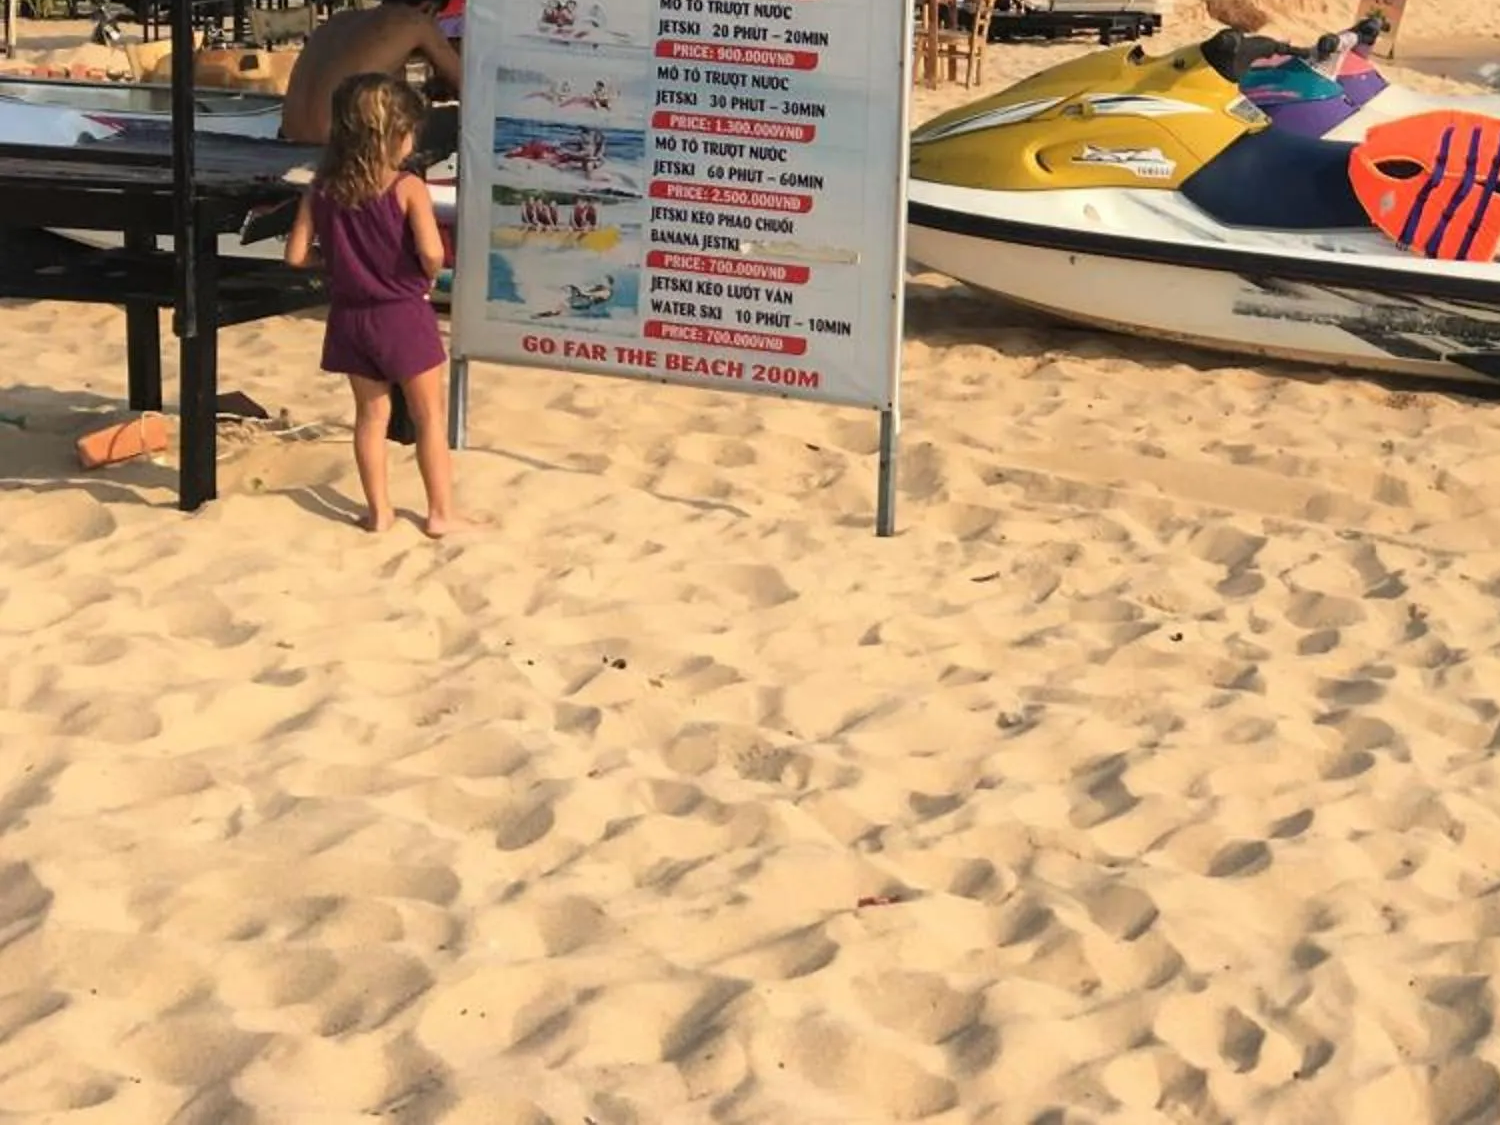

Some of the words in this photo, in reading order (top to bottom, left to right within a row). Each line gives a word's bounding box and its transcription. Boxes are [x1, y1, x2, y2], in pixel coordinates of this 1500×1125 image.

[658, 19, 700, 35] JETSKI
[713, 24, 729, 38] 20
[784, 30, 829, 46] 20MIN
[673, 43, 714, 59] PRICE:
[655, 90, 697, 106] JETSKI
[710, 95, 726, 108] 30
[782, 101, 826, 118] 30MIN
[669, 115, 712, 130] PRICE:
[653, 160, 695, 176] JETSKI
[707, 165, 724, 178] 60
[779, 172, 824, 189] 60MIN
[667, 184, 708, 199] PRICE:
[650, 206, 687, 222] JETSKI
[717, 212, 750, 229] PHAO
[651, 229, 699, 246] BANANA
[664, 254, 704, 270] PRICE:
[651, 276, 692, 293] JETSKI
[651, 299, 696, 316] WATER
[700, 305, 722, 320] SKI
[735, 309, 750, 323] 10
[809, 319, 851, 335] 10MIN
[661, 324, 702, 340] PRICE:
[522, 335, 556, 353] GO
[563, 340, 607, 361] FAR
[614, 346, 656, 368] THE
[665, 353, 744, 379] BEACH
[751, 364, 819, 387] 200M
